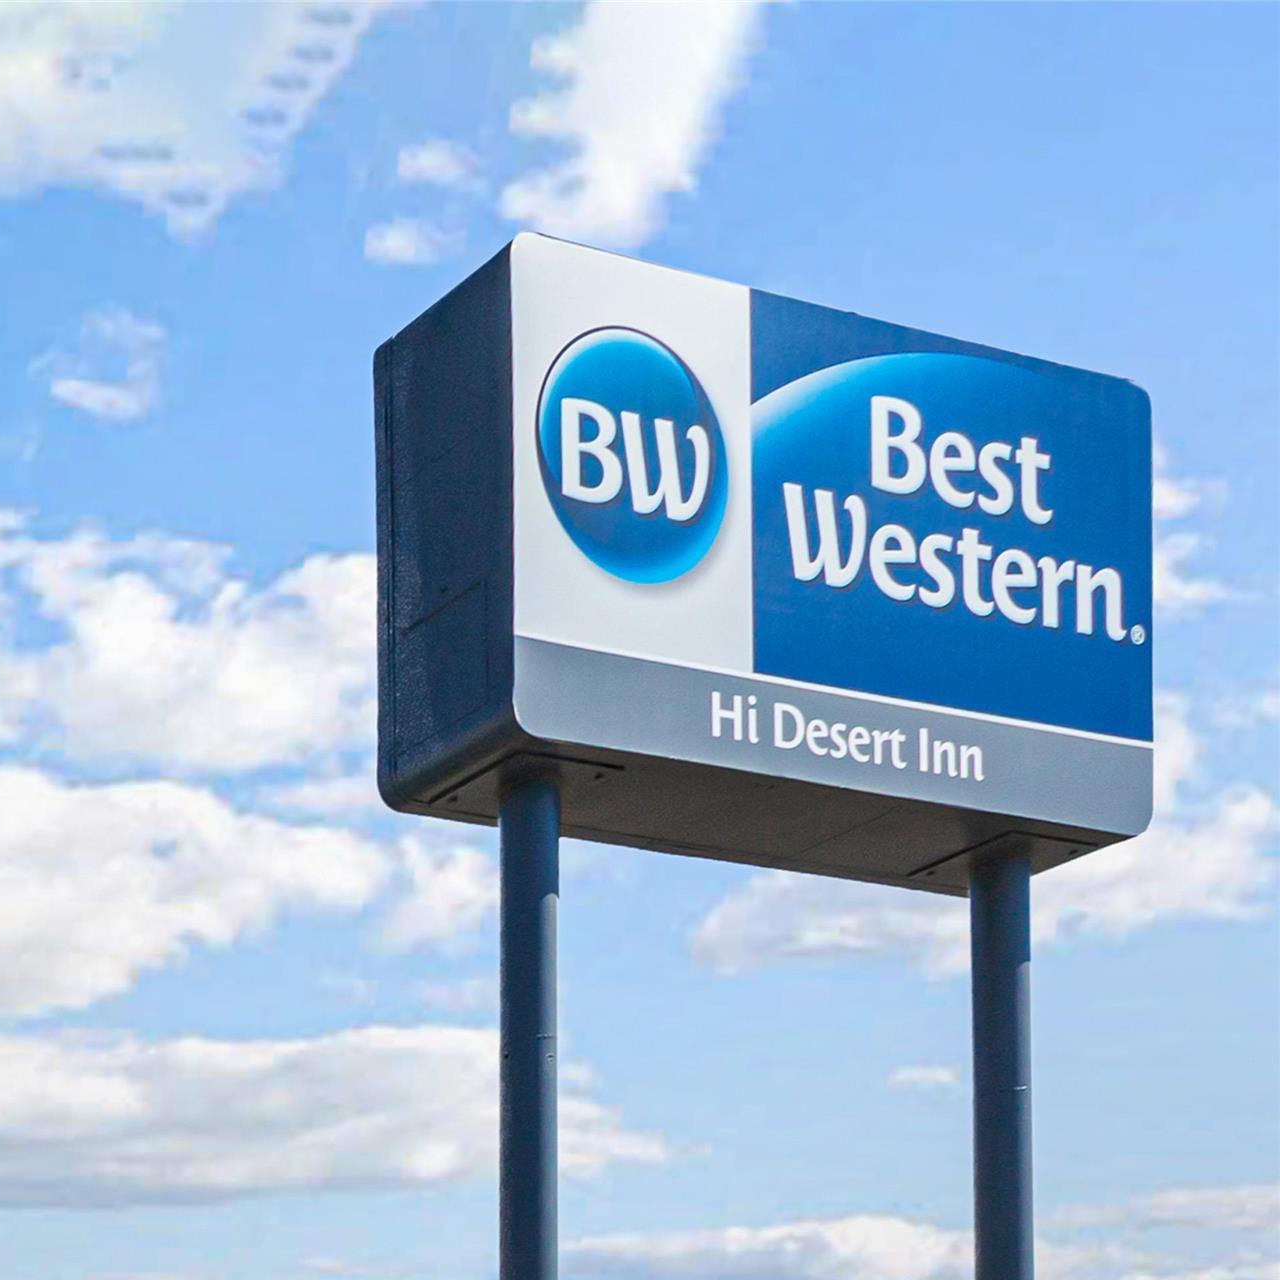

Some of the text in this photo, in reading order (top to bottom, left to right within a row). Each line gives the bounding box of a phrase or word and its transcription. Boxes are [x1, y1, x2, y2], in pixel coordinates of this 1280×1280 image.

[560, 396, 711, 522] BW
[869, 394, 1054, 526] Best
[711, 690, 986, 782] Hi Desert Inn
